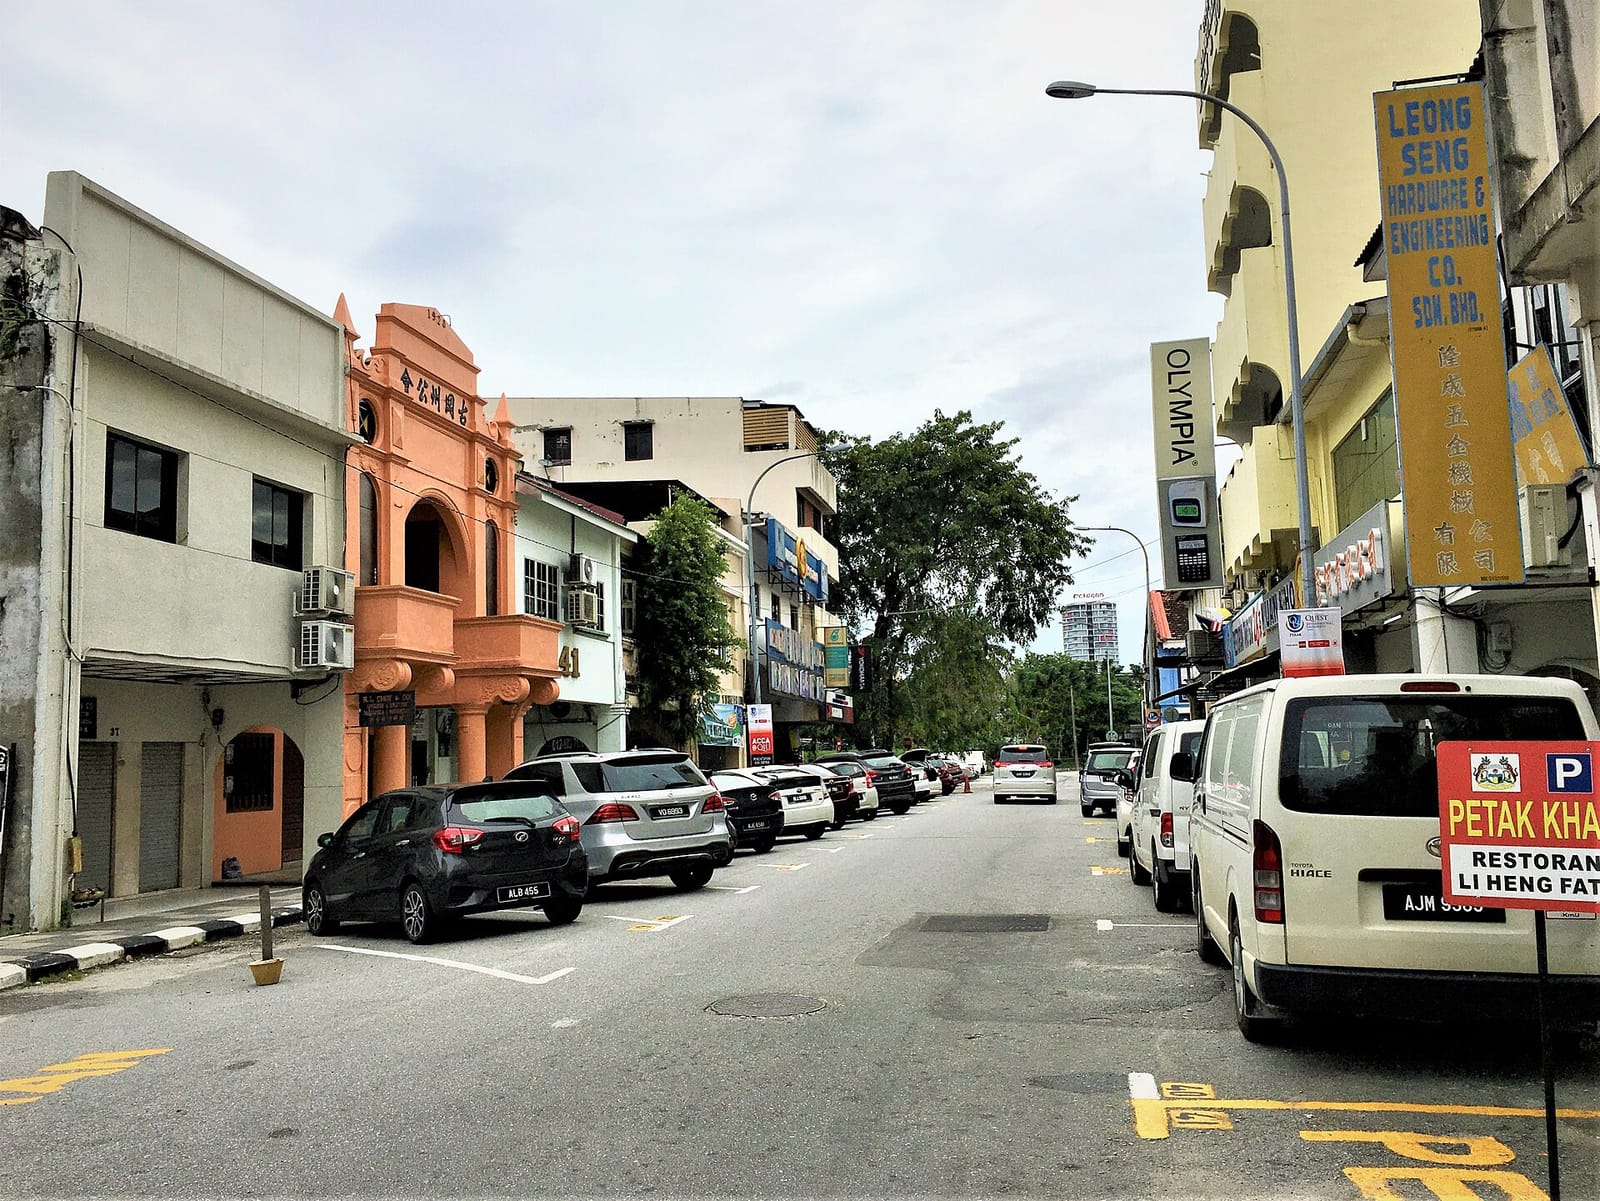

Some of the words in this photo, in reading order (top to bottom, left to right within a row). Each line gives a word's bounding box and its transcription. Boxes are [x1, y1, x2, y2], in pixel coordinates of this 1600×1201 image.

[1388, 96, 1471, 138] LEONG
[1402, 137, 1469, 176] SENG
[1388, 177, 1468, 216] HARDWARE
[1475, 176, 1485, 208] &
[1390, 214, 1489, 254] ENGINEERING
[1428, 255, 1462, 287] CO.
[1166, 348, 1196, 466] OLYMPIA
[1304, 614, 1328, 622] QUEST
[559, 645, 580, 678] 41
[109, 727, 120, 736] 37
[1555, 757, 1583, 789] P
[1448, 799, 1536, 839] PETAK
[1542, 801, 1600, 840] KHA
[1290, 869, 1333, 878] HIACE
[1472, 851, 1600, 872] RESTORAN
[508, 887, 523, 899] ALB
[524, 885, 540, 896] 455
[1458, 873, 1480, 890] LI
[1486, 874, 1553, 894] HENG
[1560, 877, 1600, 895] FAT
[1405, 894, 1437, 912] AJM
